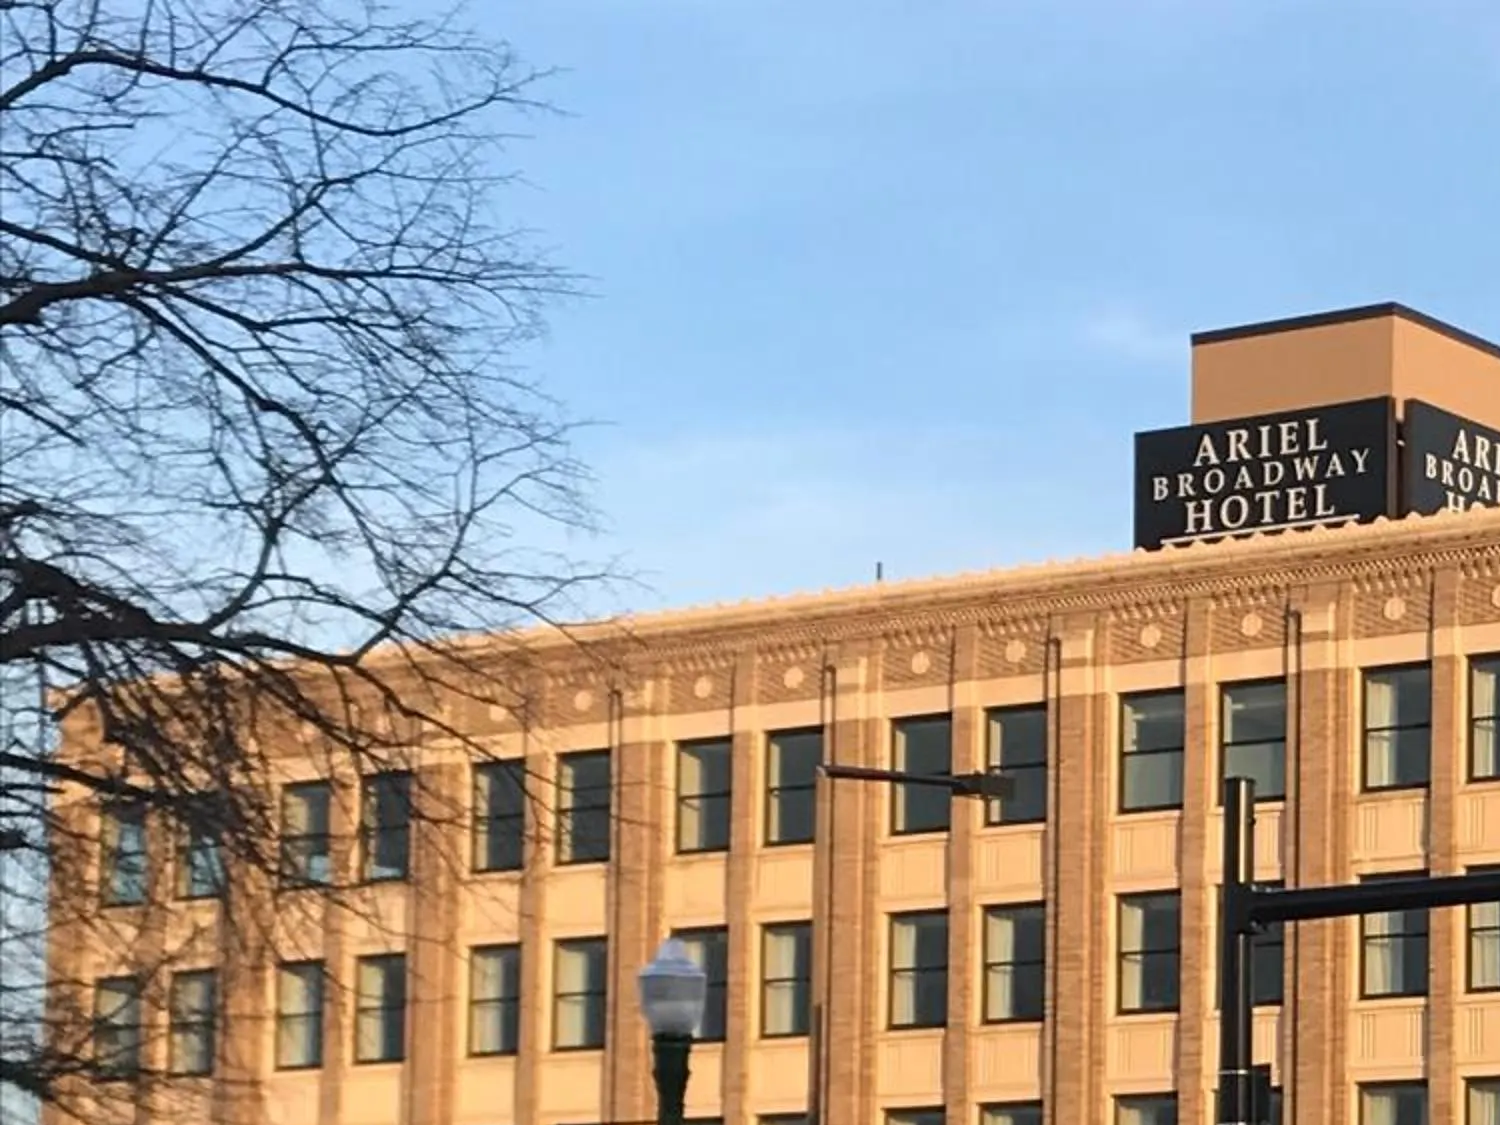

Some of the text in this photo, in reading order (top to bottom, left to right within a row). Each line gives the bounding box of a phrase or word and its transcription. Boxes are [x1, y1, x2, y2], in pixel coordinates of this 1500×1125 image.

[1193, 418, 1328, 467] ARIEL
[1153, 448, 1370, 501] BROADWAY
[1184, 484, 1335, 534] HOTEL
